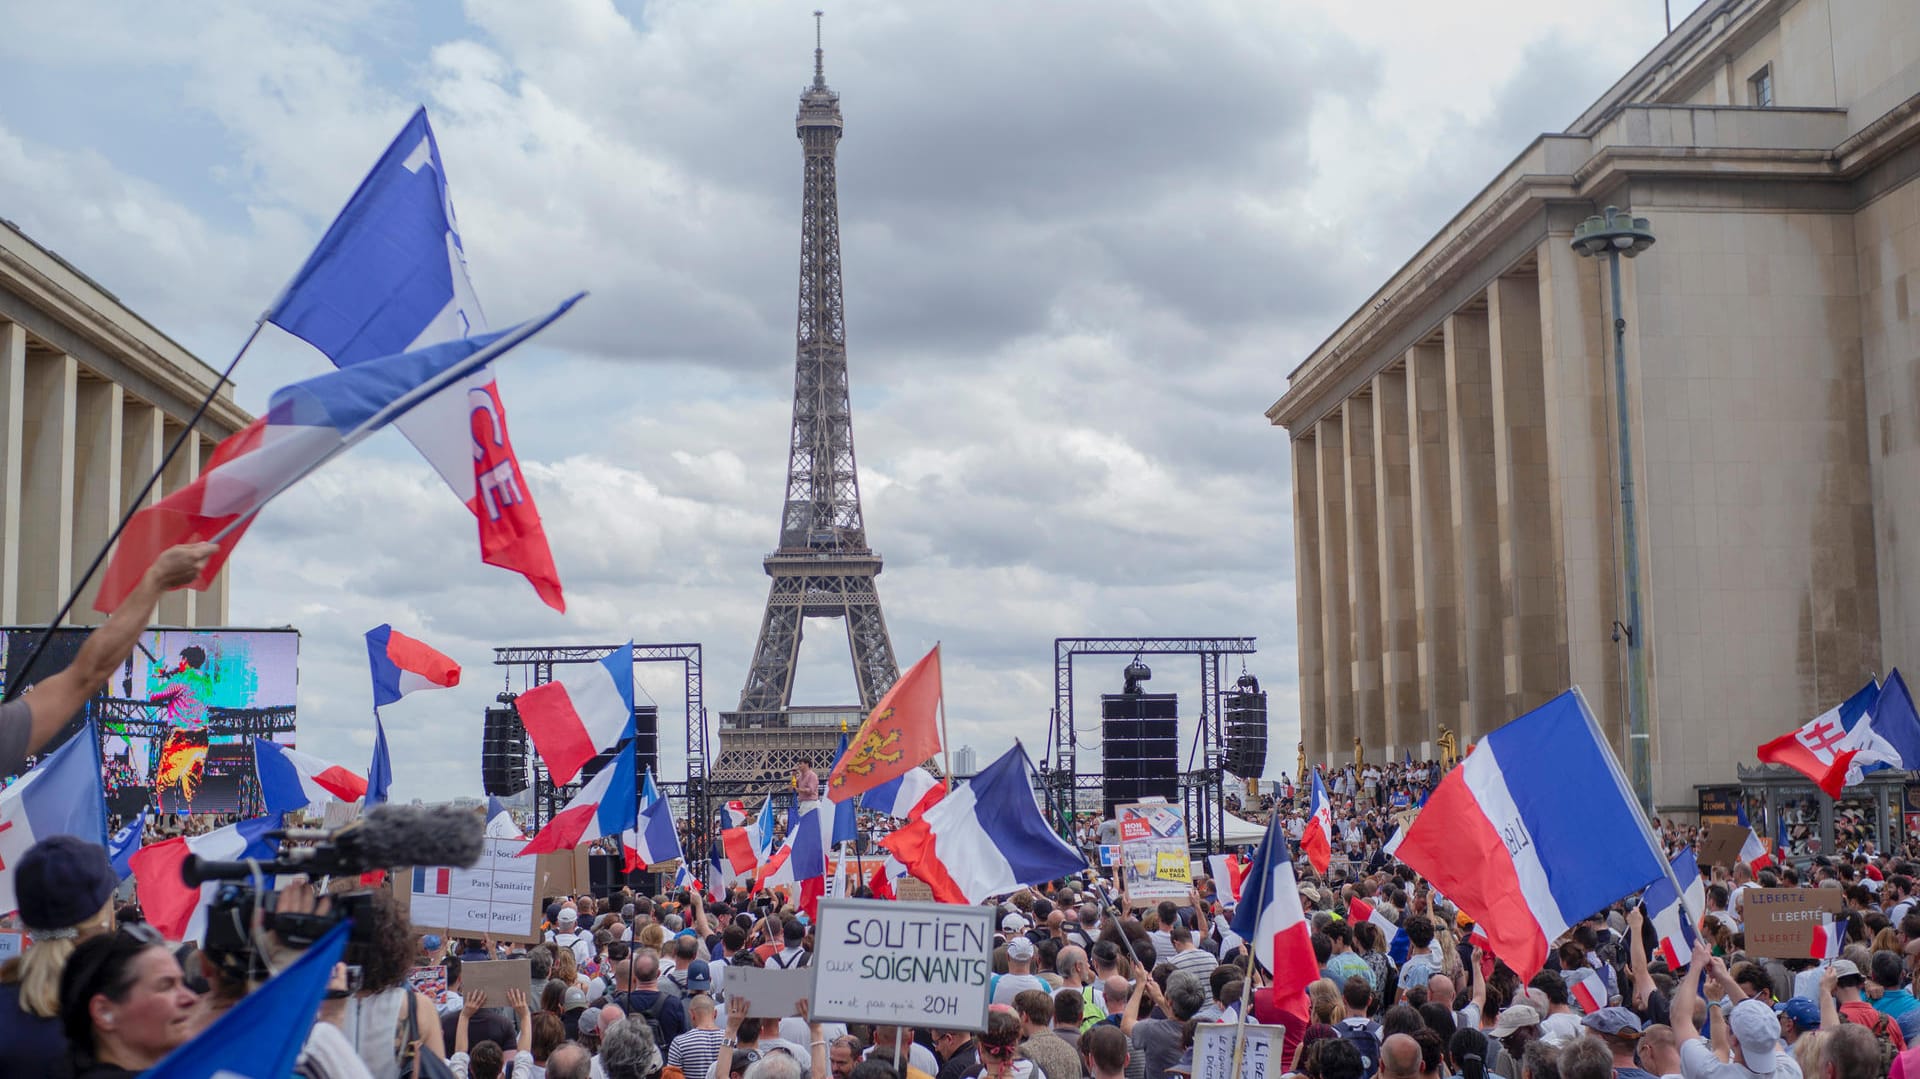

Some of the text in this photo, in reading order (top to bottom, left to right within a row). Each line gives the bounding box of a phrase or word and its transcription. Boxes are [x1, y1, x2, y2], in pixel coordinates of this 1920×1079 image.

[493, 881, 532, 892] Sanitaire
[468, 910, 488, 919] C'est
[1771, 905, 1823, 922] LIBERTÉ
[1753, 931, 1803, 943] LIBERTÉ
[825, 959, 854, 973] aux
[923, 994, 959, 1015] 20H
